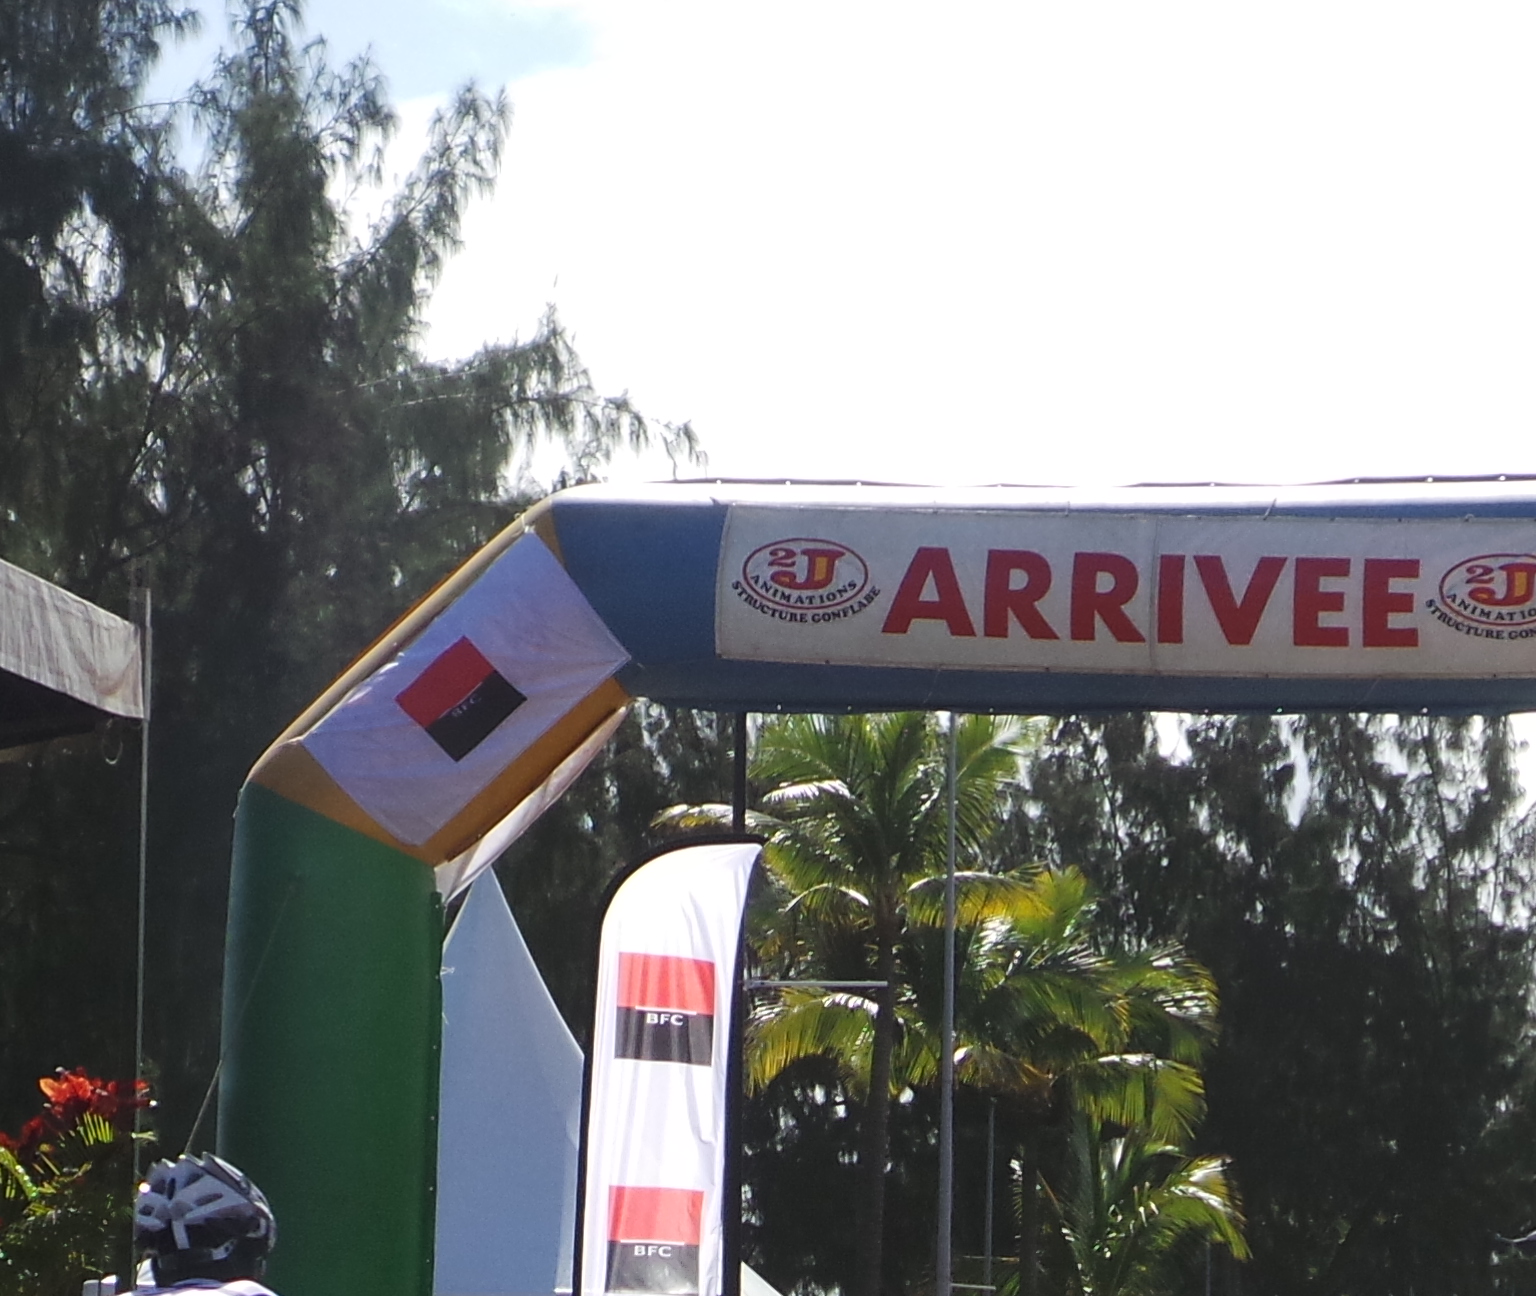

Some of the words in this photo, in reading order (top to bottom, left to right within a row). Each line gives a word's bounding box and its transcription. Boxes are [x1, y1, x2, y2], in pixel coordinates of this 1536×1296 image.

[731, 580, 809, 623] STRUCTURE
[750, 573, 858, 606] ANIMATIONS
[880, 546, 1421, 649] ARRIVEE
[1425, 598, 1505, 640] STRUCTURE
[646, 1012, 684, 1026] BFC
[634, 1244, 672, 1258] BFC
